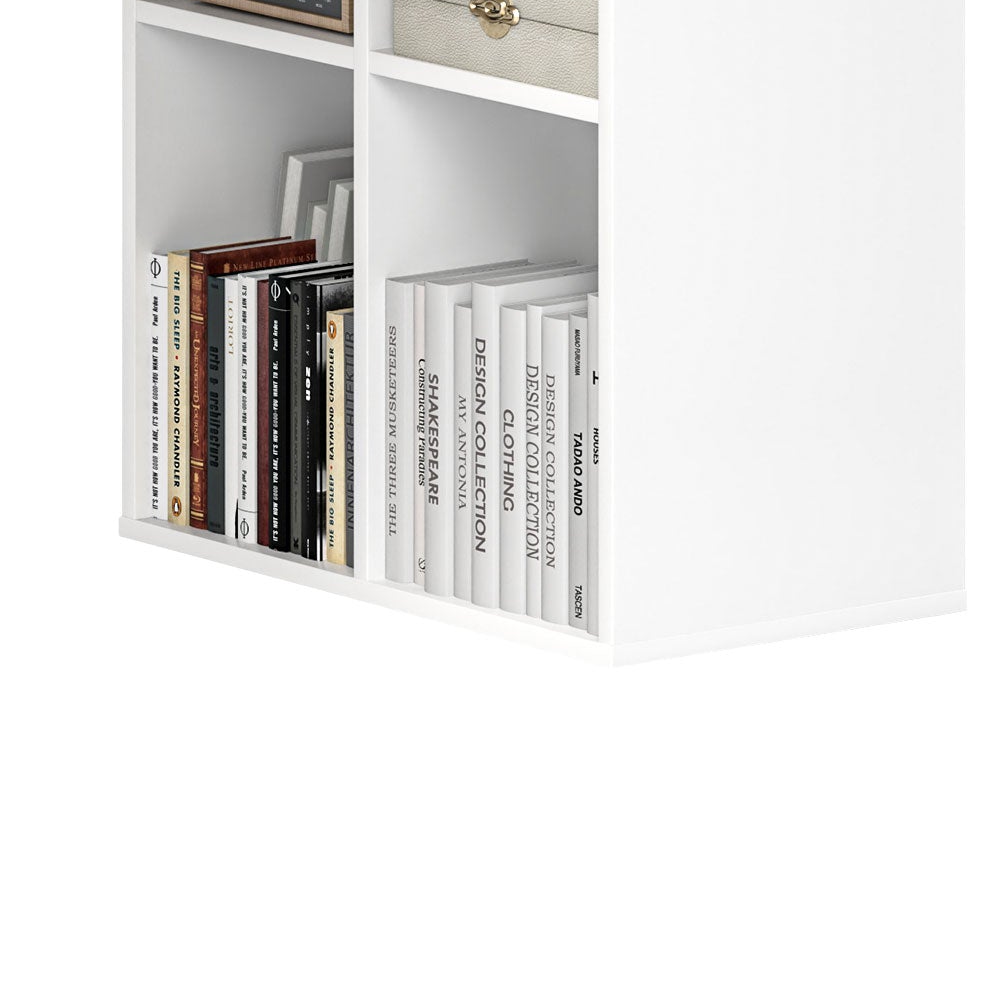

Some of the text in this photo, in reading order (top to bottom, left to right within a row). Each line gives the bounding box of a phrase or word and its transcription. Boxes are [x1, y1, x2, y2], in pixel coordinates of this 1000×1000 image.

[250, 260, 267, 270] LINE
[269, 257, 304, 267] PLATINUM
[152, 346, 158, 354] TO
[210, 346, 220, 370] arts
[210, 391, 221, 468] architecture
[242, 443, 247, 451] TO
[388, 325, 396, 536] THE THREE MUSKETEERS
[428, 373, 439, 505] SHAKESPEARE
[459, 395, 467, 510] MY ANTONIA
[475, 338, 486, 553] DESIGN COLLECTION
[503, 408, 515, 511] CLOTHING
[525, 364, 540, 560] DESIGN COLLECTION
[545, 374, 556, 568] DESIGN COLLECTION
[574, 432, 583, 516] TADAO ANDO
